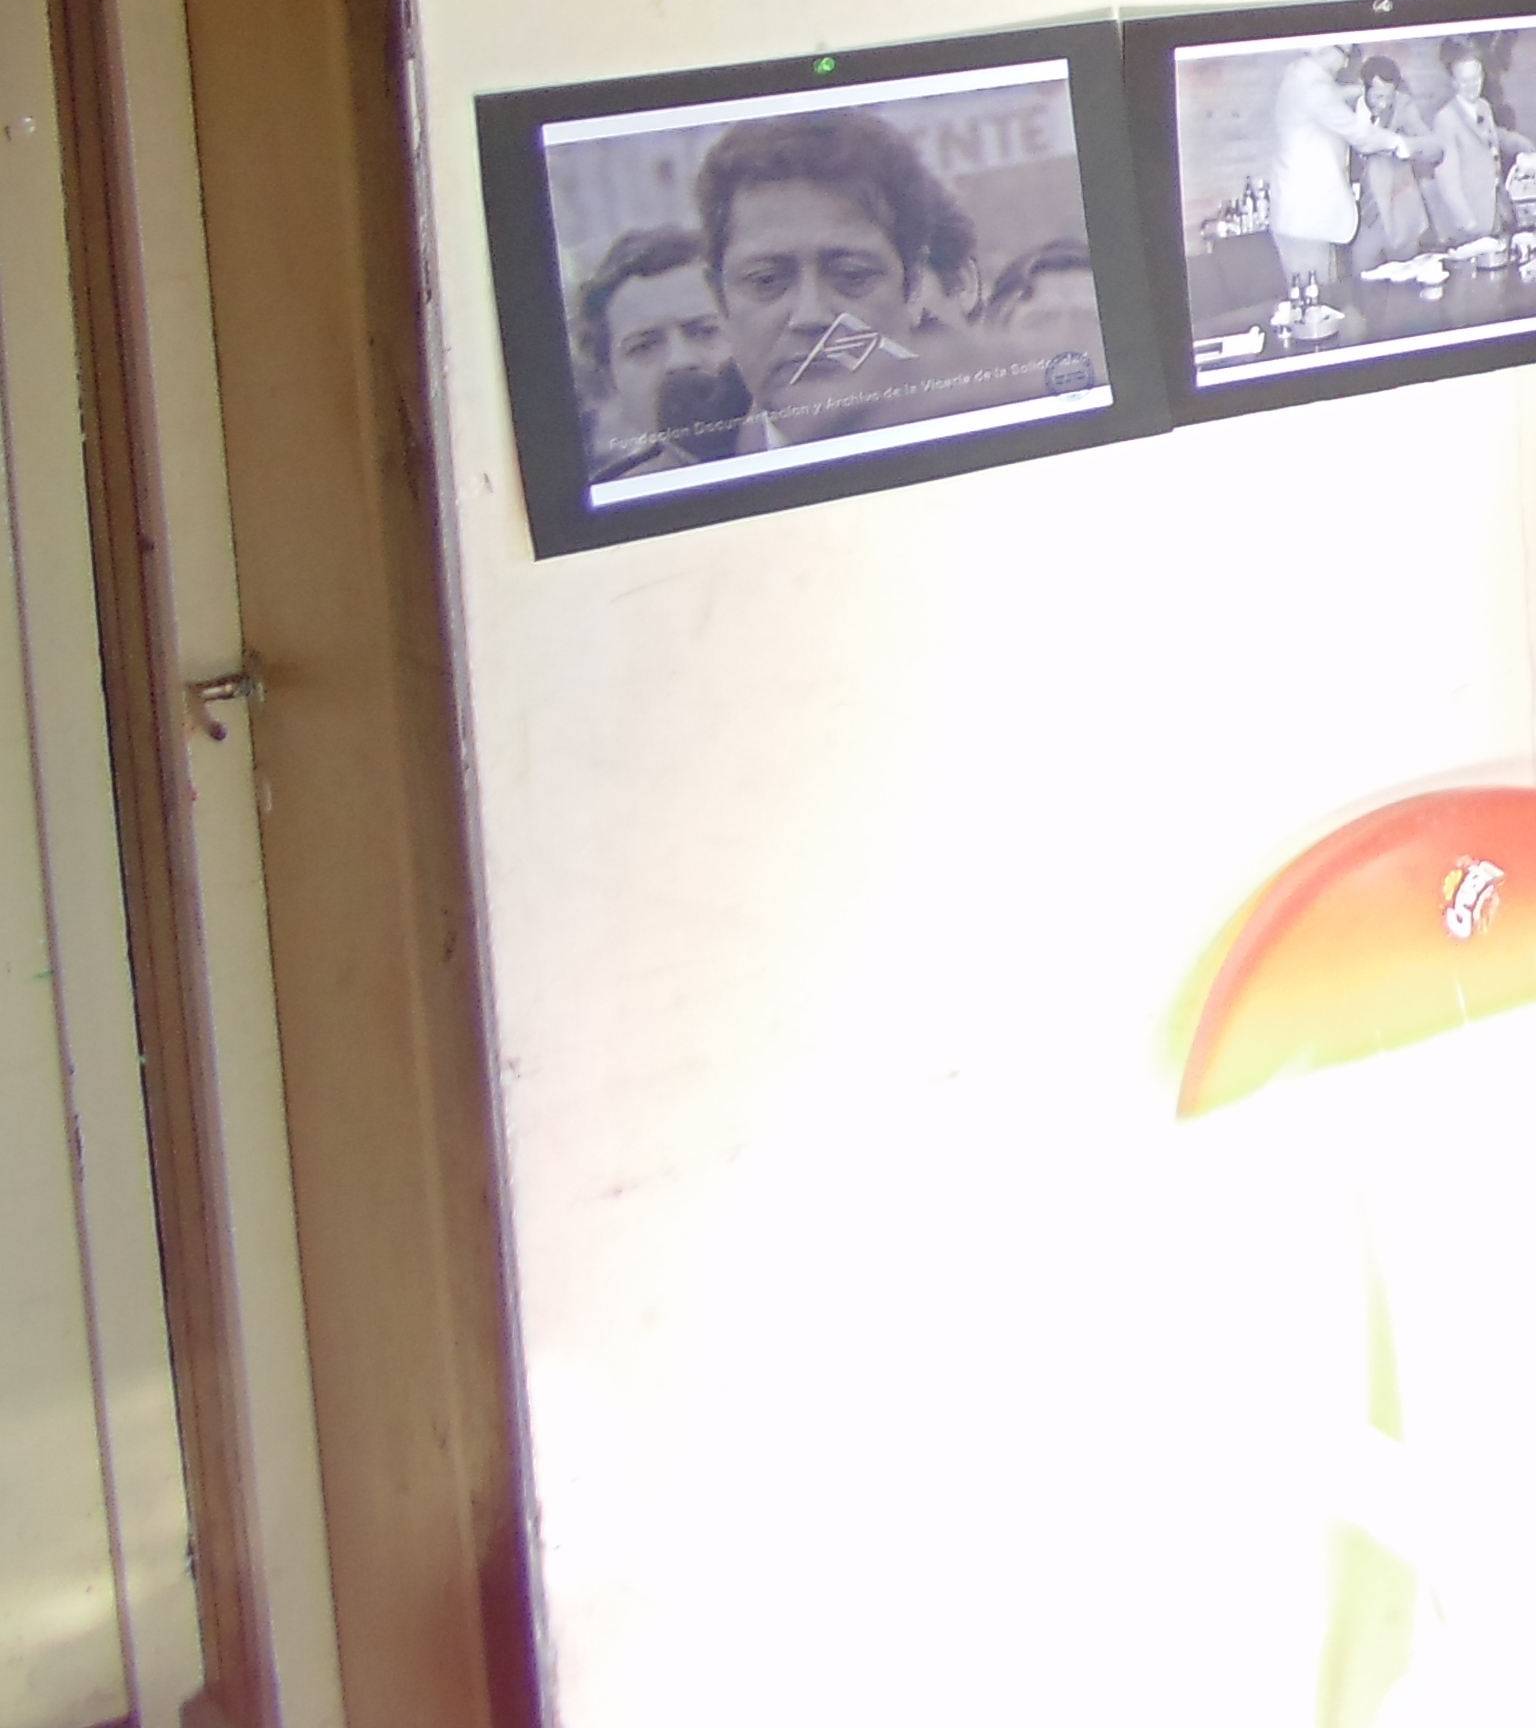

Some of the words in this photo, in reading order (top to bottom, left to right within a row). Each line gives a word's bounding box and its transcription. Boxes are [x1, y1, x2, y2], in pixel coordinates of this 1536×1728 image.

[811, 402, 822, 416] y
[825, 390, 880, 410] Archivo
[883, 384, 902, 399] de
[904, 383, 918, 396] la
[974, 369, 992, 383] de
[995, 367, 1008, 379] la
